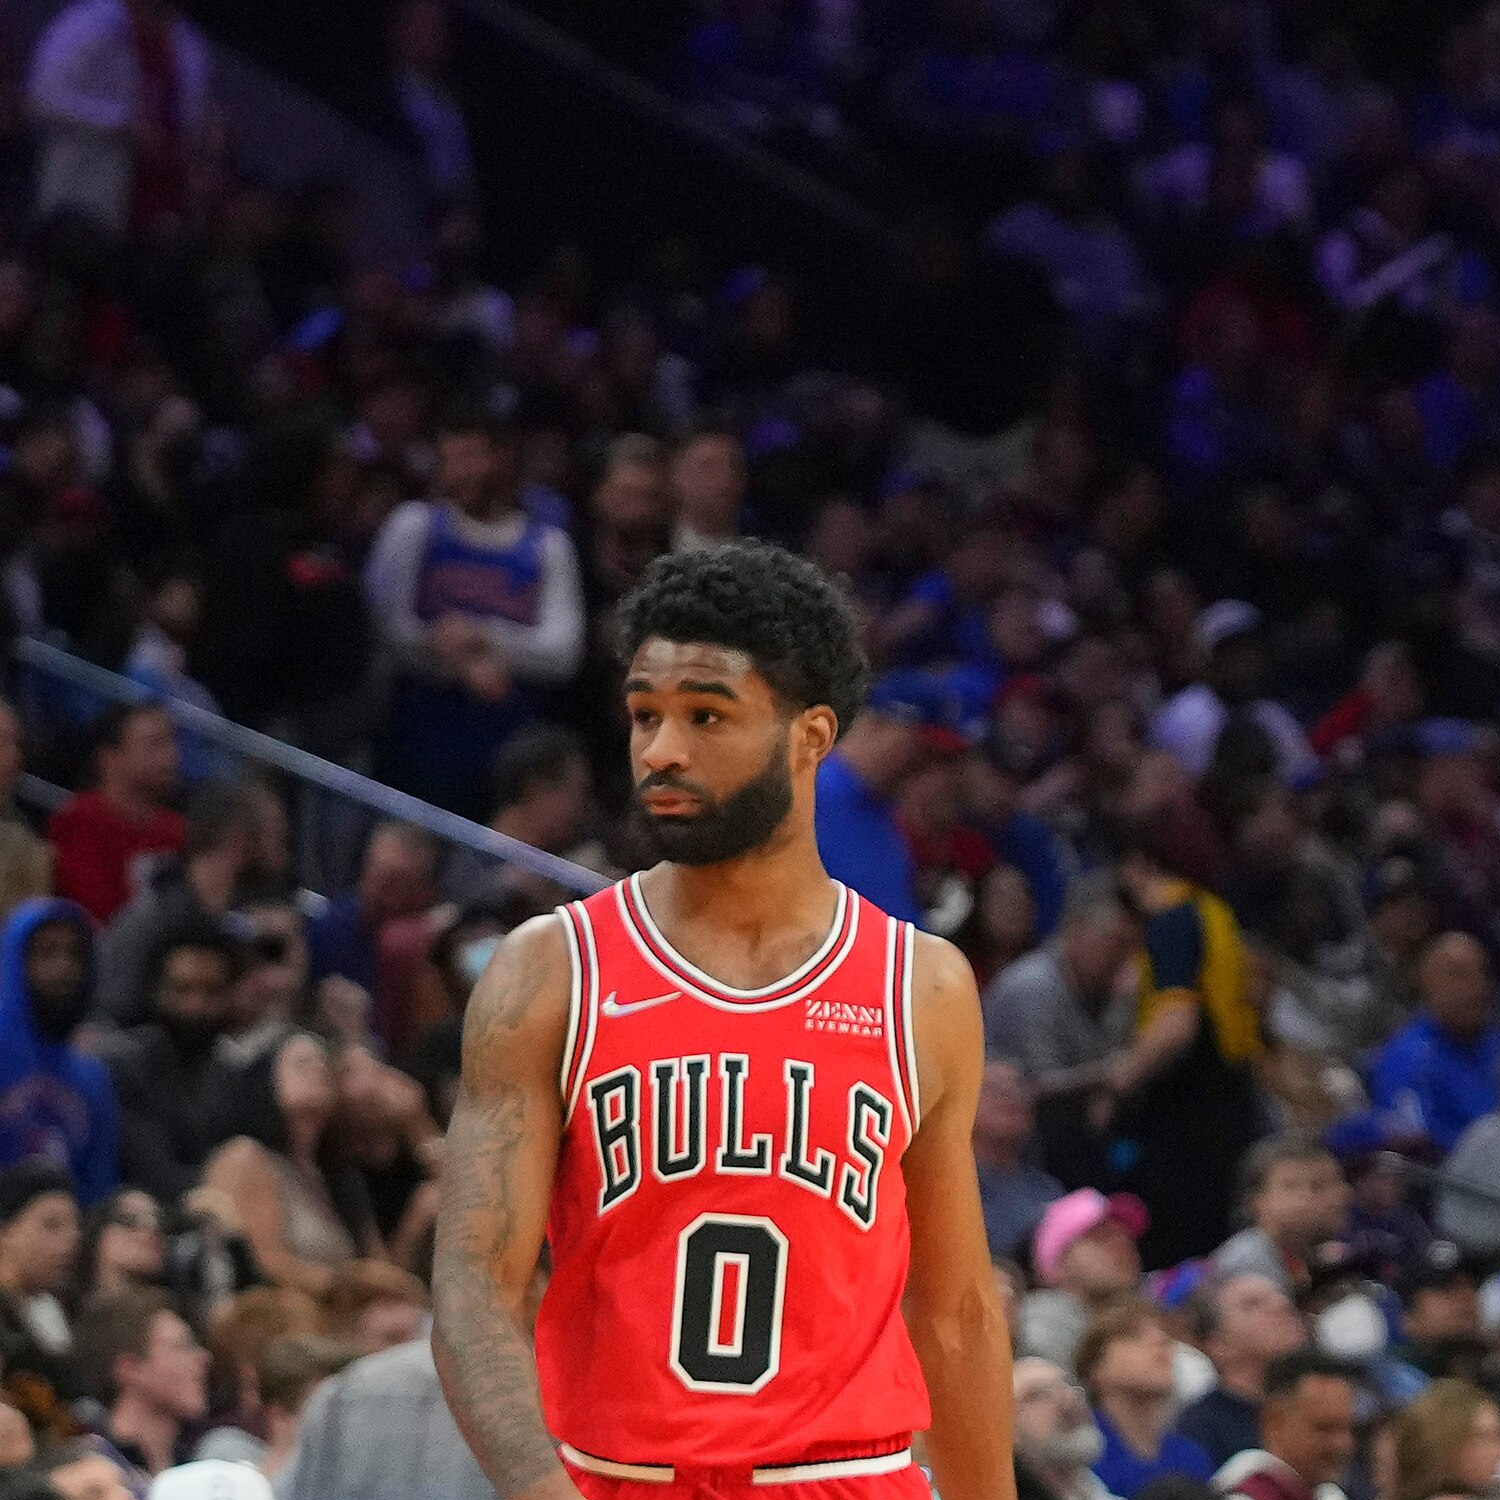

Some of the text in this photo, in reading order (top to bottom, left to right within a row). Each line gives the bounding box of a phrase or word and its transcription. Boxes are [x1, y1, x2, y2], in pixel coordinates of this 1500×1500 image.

[804, 1019, 883, 1037] EYEWEAR
[805, 1000, 882, 1026] ZENNI
[586, 1053, 893, 1231] BULLS
[668, 1211, 789, 1395] 0
